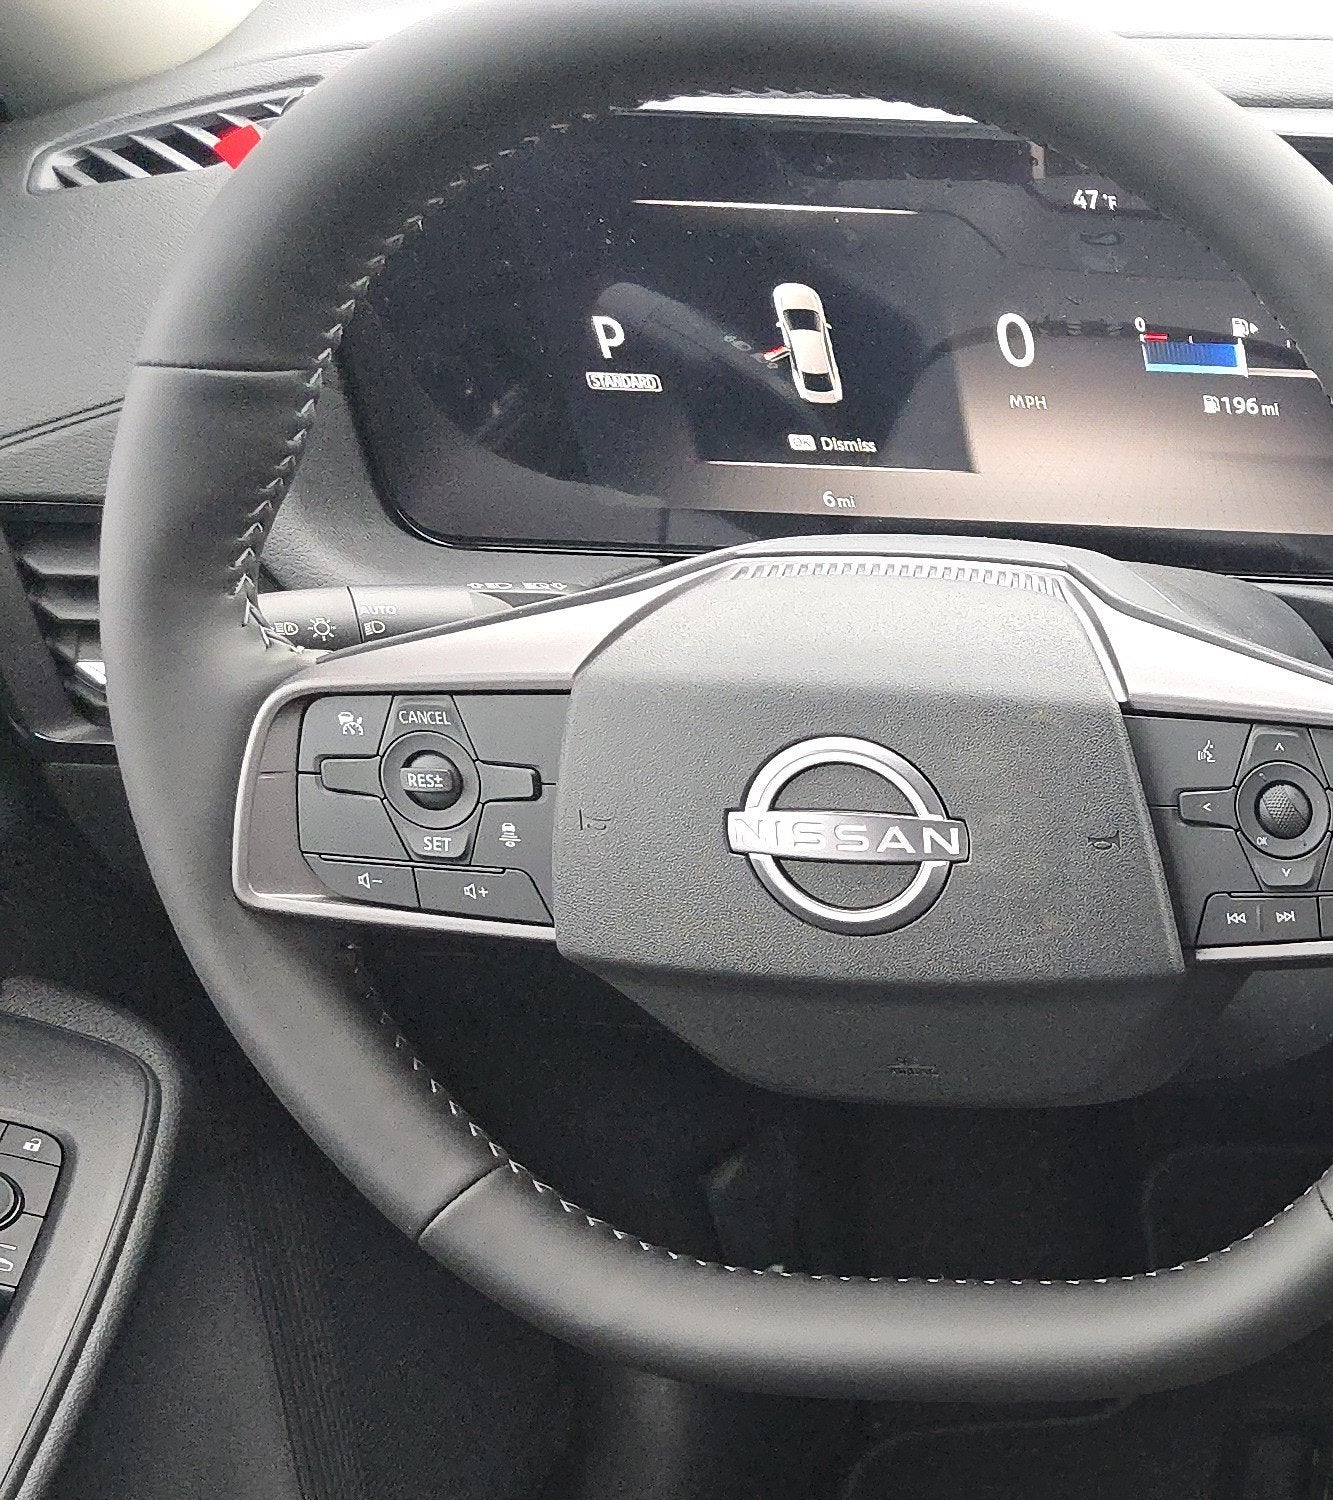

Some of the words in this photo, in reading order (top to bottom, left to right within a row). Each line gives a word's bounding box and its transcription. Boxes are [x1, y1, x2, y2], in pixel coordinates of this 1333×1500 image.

[1073, 189, 1098, 210] 47
[1134, 316, 1146, 331] 0
[592, 315, 625, 359] P
[996, 312, 1035, 368] 0
[591, 375, 657, 390] STANDARD
[1009, 394, 1048, 410] MPH
[1219, 398, 1259, 416] 196
[1261, 401, 1280, 416] mi
[820, 436, 877, 453] Dismiss
[822, 490, 836, 508] 6
[836, 495, 857, 508] mi
[360, 604, 398, 616] AUTO
[398, 710, 452, 726] CANCEL
[423, 837, 452, 852] SET
[735, 818, 960, 855] NISSAN
[1256, 836, 1269, 846] OK
